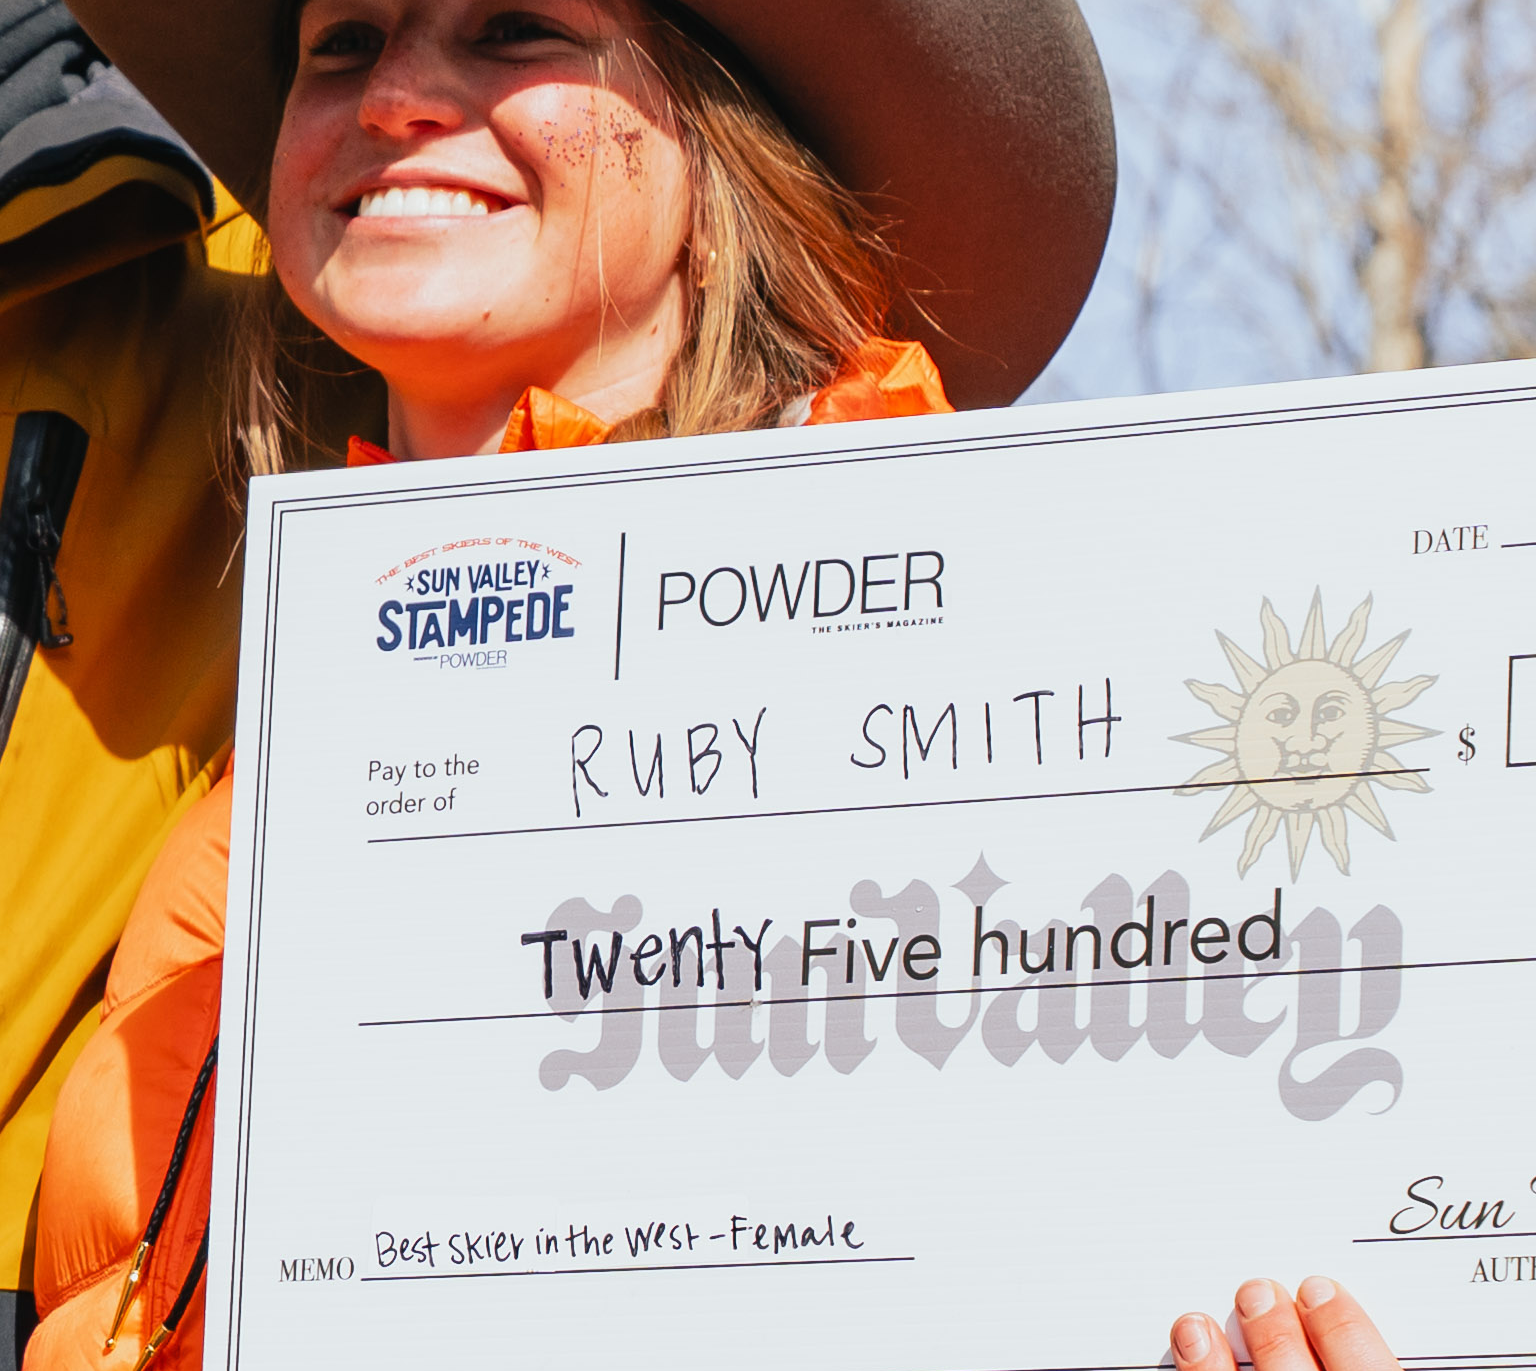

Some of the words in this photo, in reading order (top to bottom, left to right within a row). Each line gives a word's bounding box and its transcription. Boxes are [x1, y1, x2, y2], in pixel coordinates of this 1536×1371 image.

[404, 547, 438, 569] BEST
[442, 537, 491, 553] SKIERS
[496, 537, 513, 546] OF
[517, 539, 542, 552] THE
[546, 547, 583, 569] WEST
[1413, 524, 1489, 555] DATE
[416, 566, 460, 597] SUN
[468, 560, 540, 593] VALLEY
[655, 547, 947, 631] POWDER
[377, 584, 575, 651] STAMPEDE
[812, 626, 831, 634] THE
[887, 616, 944, 627] MAGAZINE
[440, 650, 507, 669] POWDER
[571, 706, 767, 819] RUBY
[850, 677, 1122, 781] SMITH
[1457, 723, 1477, 766] $
[368, 760, 407, 787] Pay
[413, 760, 437, 779] to
[443, 753, 480, 777] the
[366, 793, 426, 816] order
[433, 787, 457, 812] of
[801, 918, 942, 986] Five
[973, 887, 1282, 977] hundred
[1389, 1175, 1514, 1235] Sun
[375, 1231, 441, 1268] Best
[535, 1227, 559, 1255] in
[564, 1224, 614, 1258] the
[279, 1256, 355, 1283] MEMO
